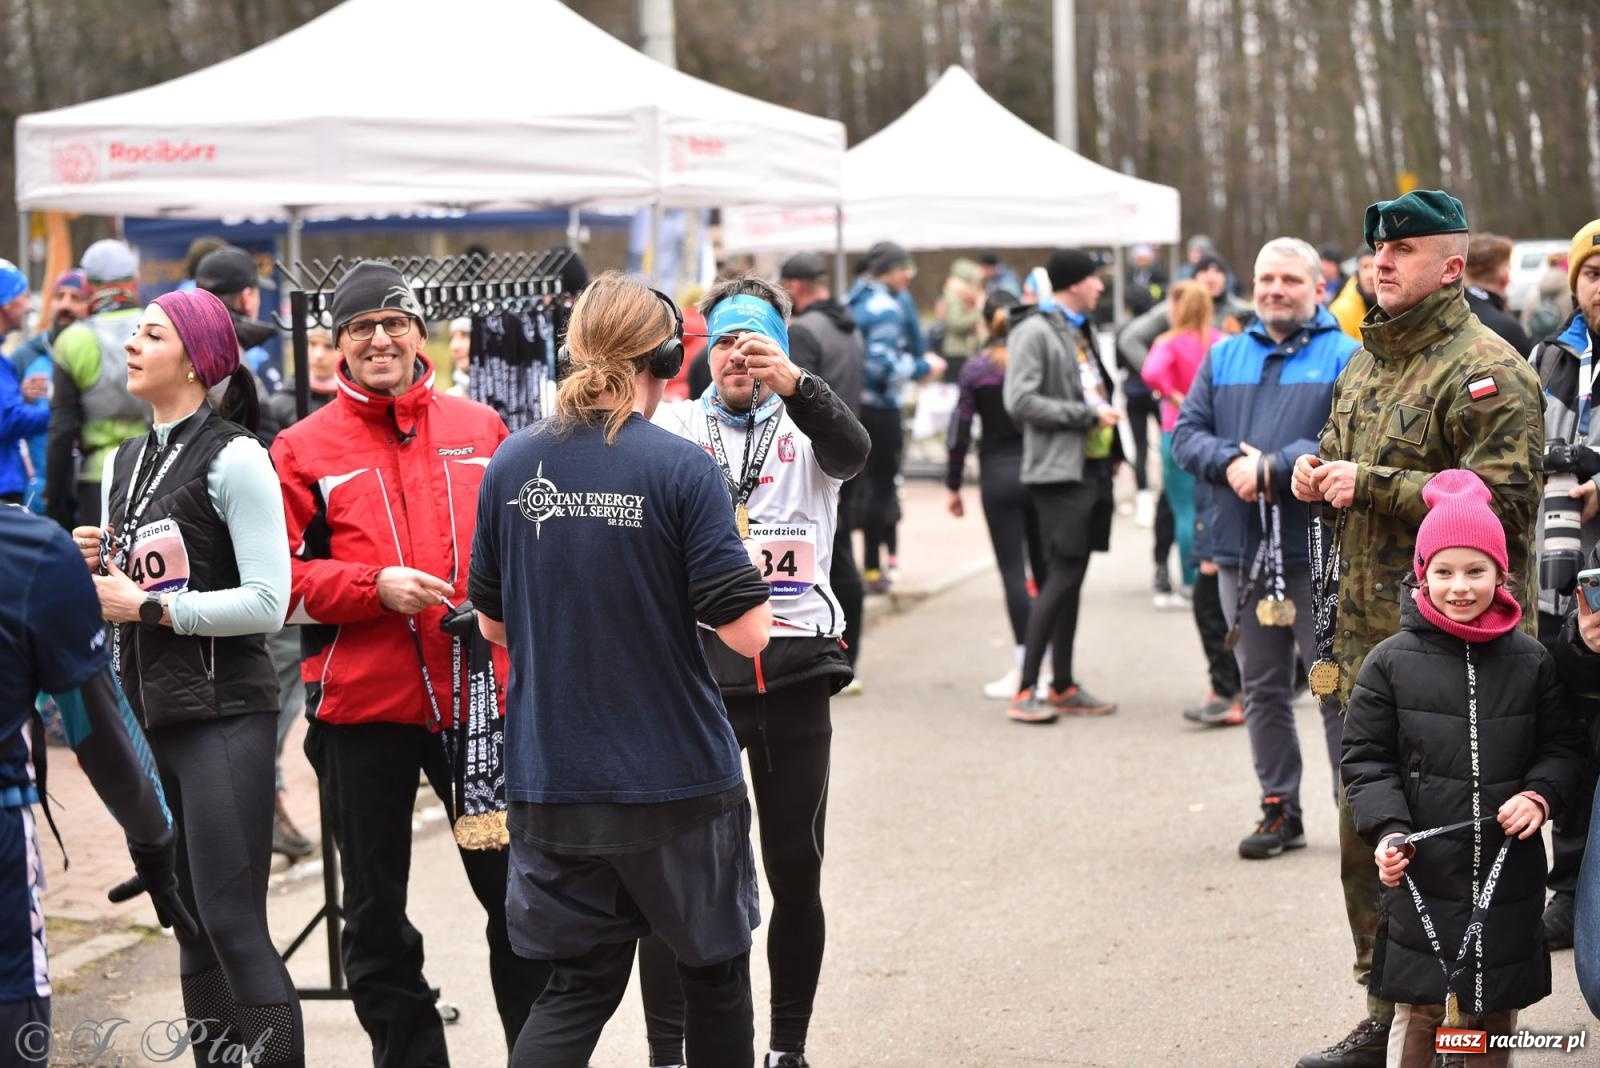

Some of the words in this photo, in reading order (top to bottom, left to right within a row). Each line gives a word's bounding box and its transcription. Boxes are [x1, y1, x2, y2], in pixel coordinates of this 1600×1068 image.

[109, 141, 217, 163] Racibórz
[438, 446, 474, 455] SPYDER
[532, 493, 583, 506] OKTAN
[585, 493, 645, 508] ENERGY
[555, 506, 566, 517] &
[568, 506, 587, 517] V/L
[589, 506, 643, 520] SERVICE
[135, 524, 171, 541] ardziela
[132, 551, 166, 585] 40
[477, 671, 486, 734] TWARDZIELA
[1469, 698, 1477, 724] COOL
[1469, 725, 1477, 739] SO
[467, 739, 477, 763] BIEG
[478, 736, 487, 762] BIEG
[1470, 740, 1478, 750] IS
[467, 764, 476, 776] 13
[478, 762, 487, 774] 13
[1471, 751, 1479, 777] LOVE
[1472, 792, 1480, 817] COOL
[1474, 834, 1481, 843] IS
[1473, 844, 1481, 867] LOVE
[1478, 847, 1508, 910] 23.02.2025
[1421, 914, 1437, 939] BIEG
[1431, 940, 1441, 952] 13
